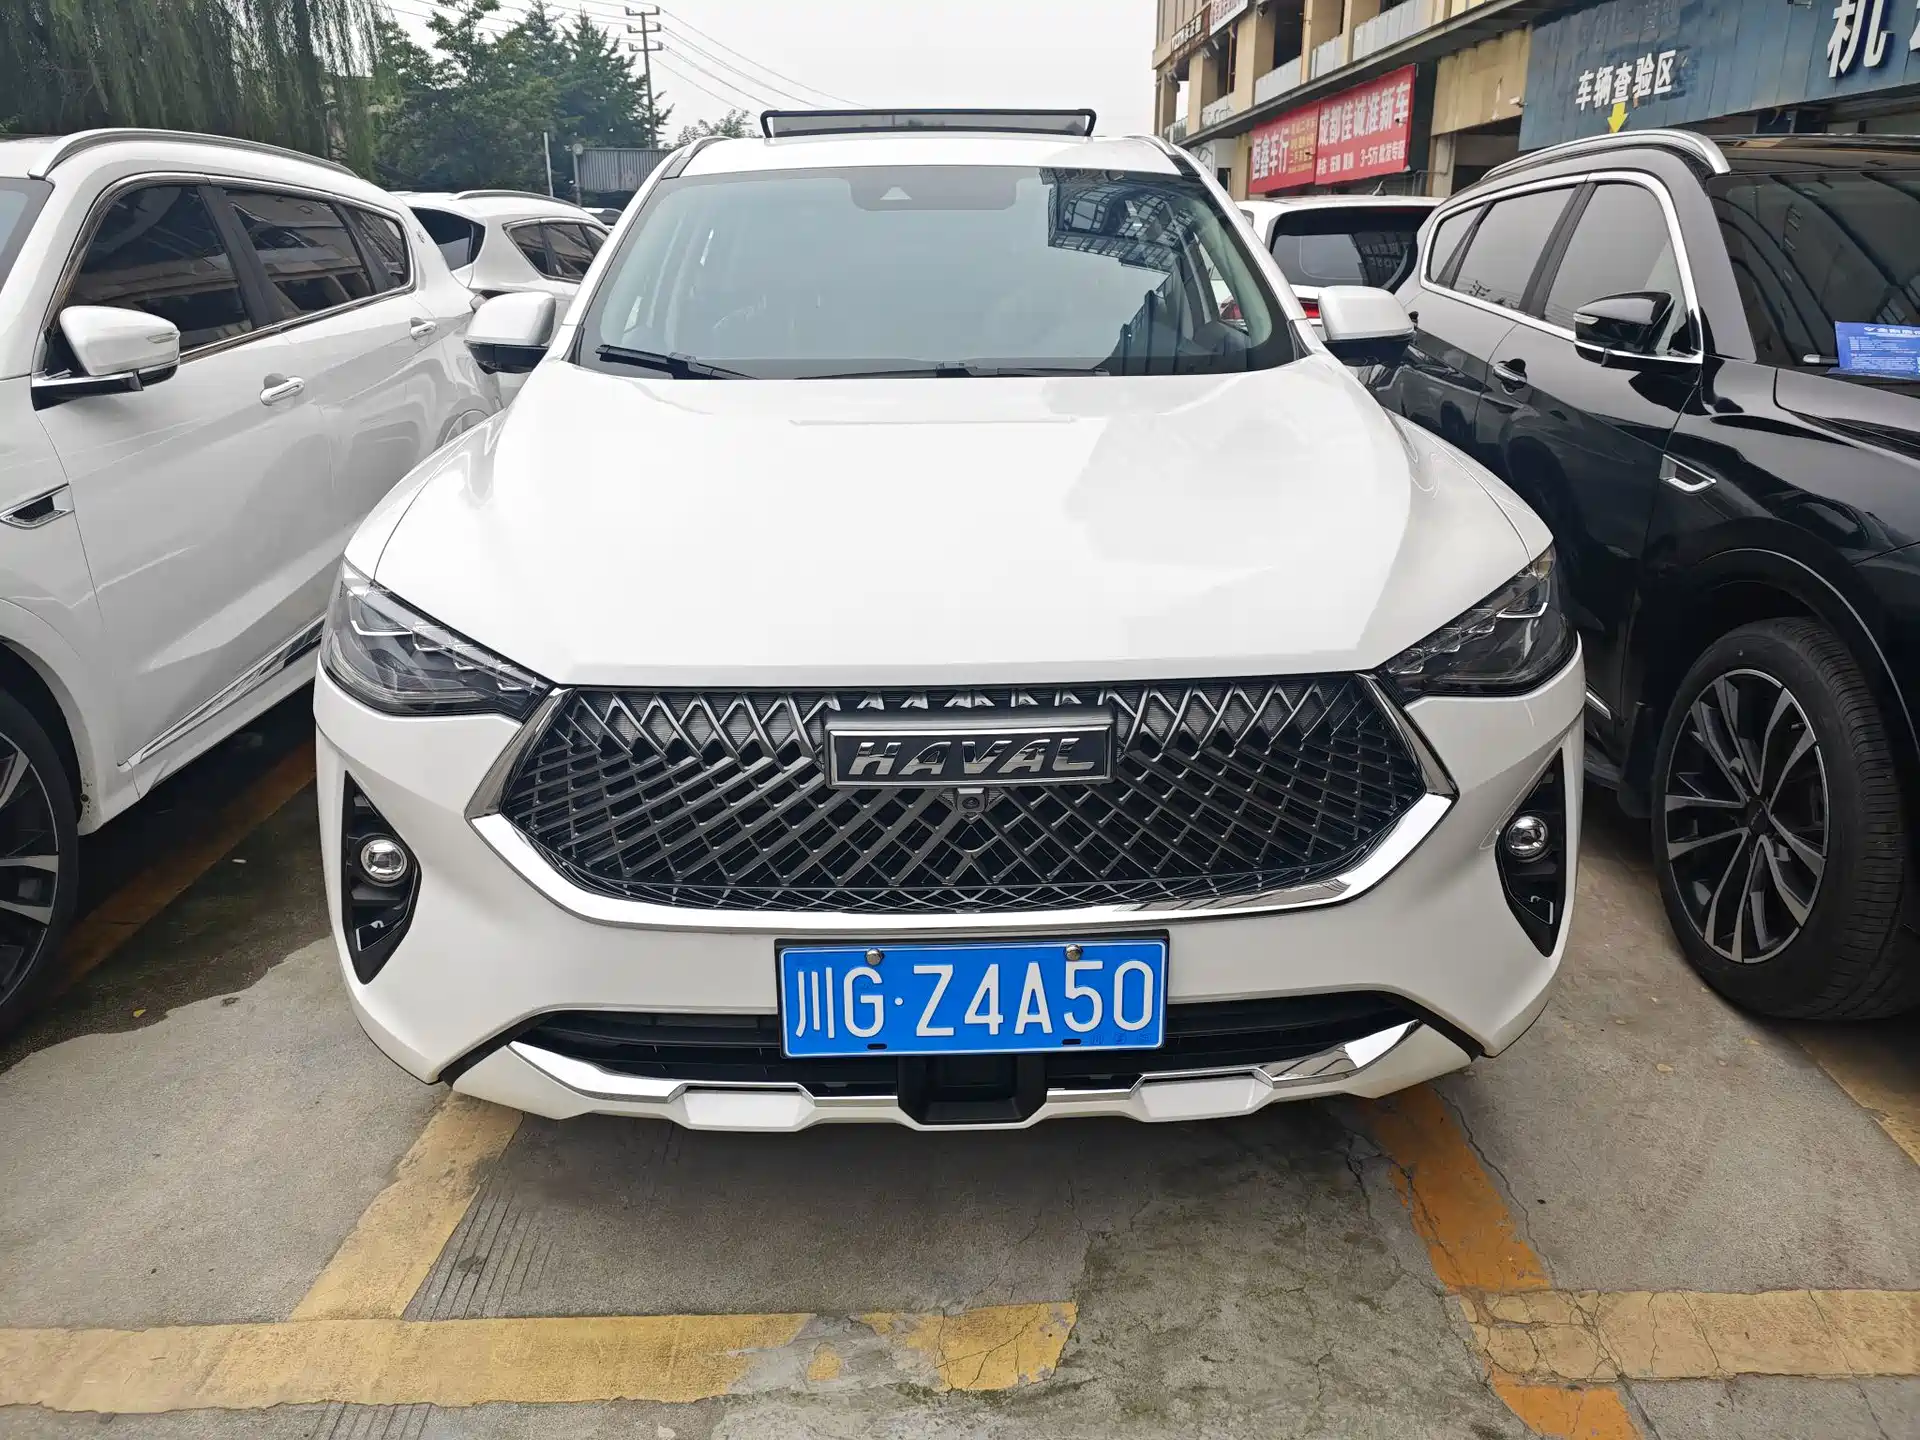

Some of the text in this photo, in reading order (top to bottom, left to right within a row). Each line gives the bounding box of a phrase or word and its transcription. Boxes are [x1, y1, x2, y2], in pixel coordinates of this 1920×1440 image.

[1827, 0, 1920, 78] 机
[1575, 49, 1677, 111] 车辆查验区
[848, 738, 1095, 775] HAVAL
[795, 960, 1154, 1039] 川G·Z4A50
